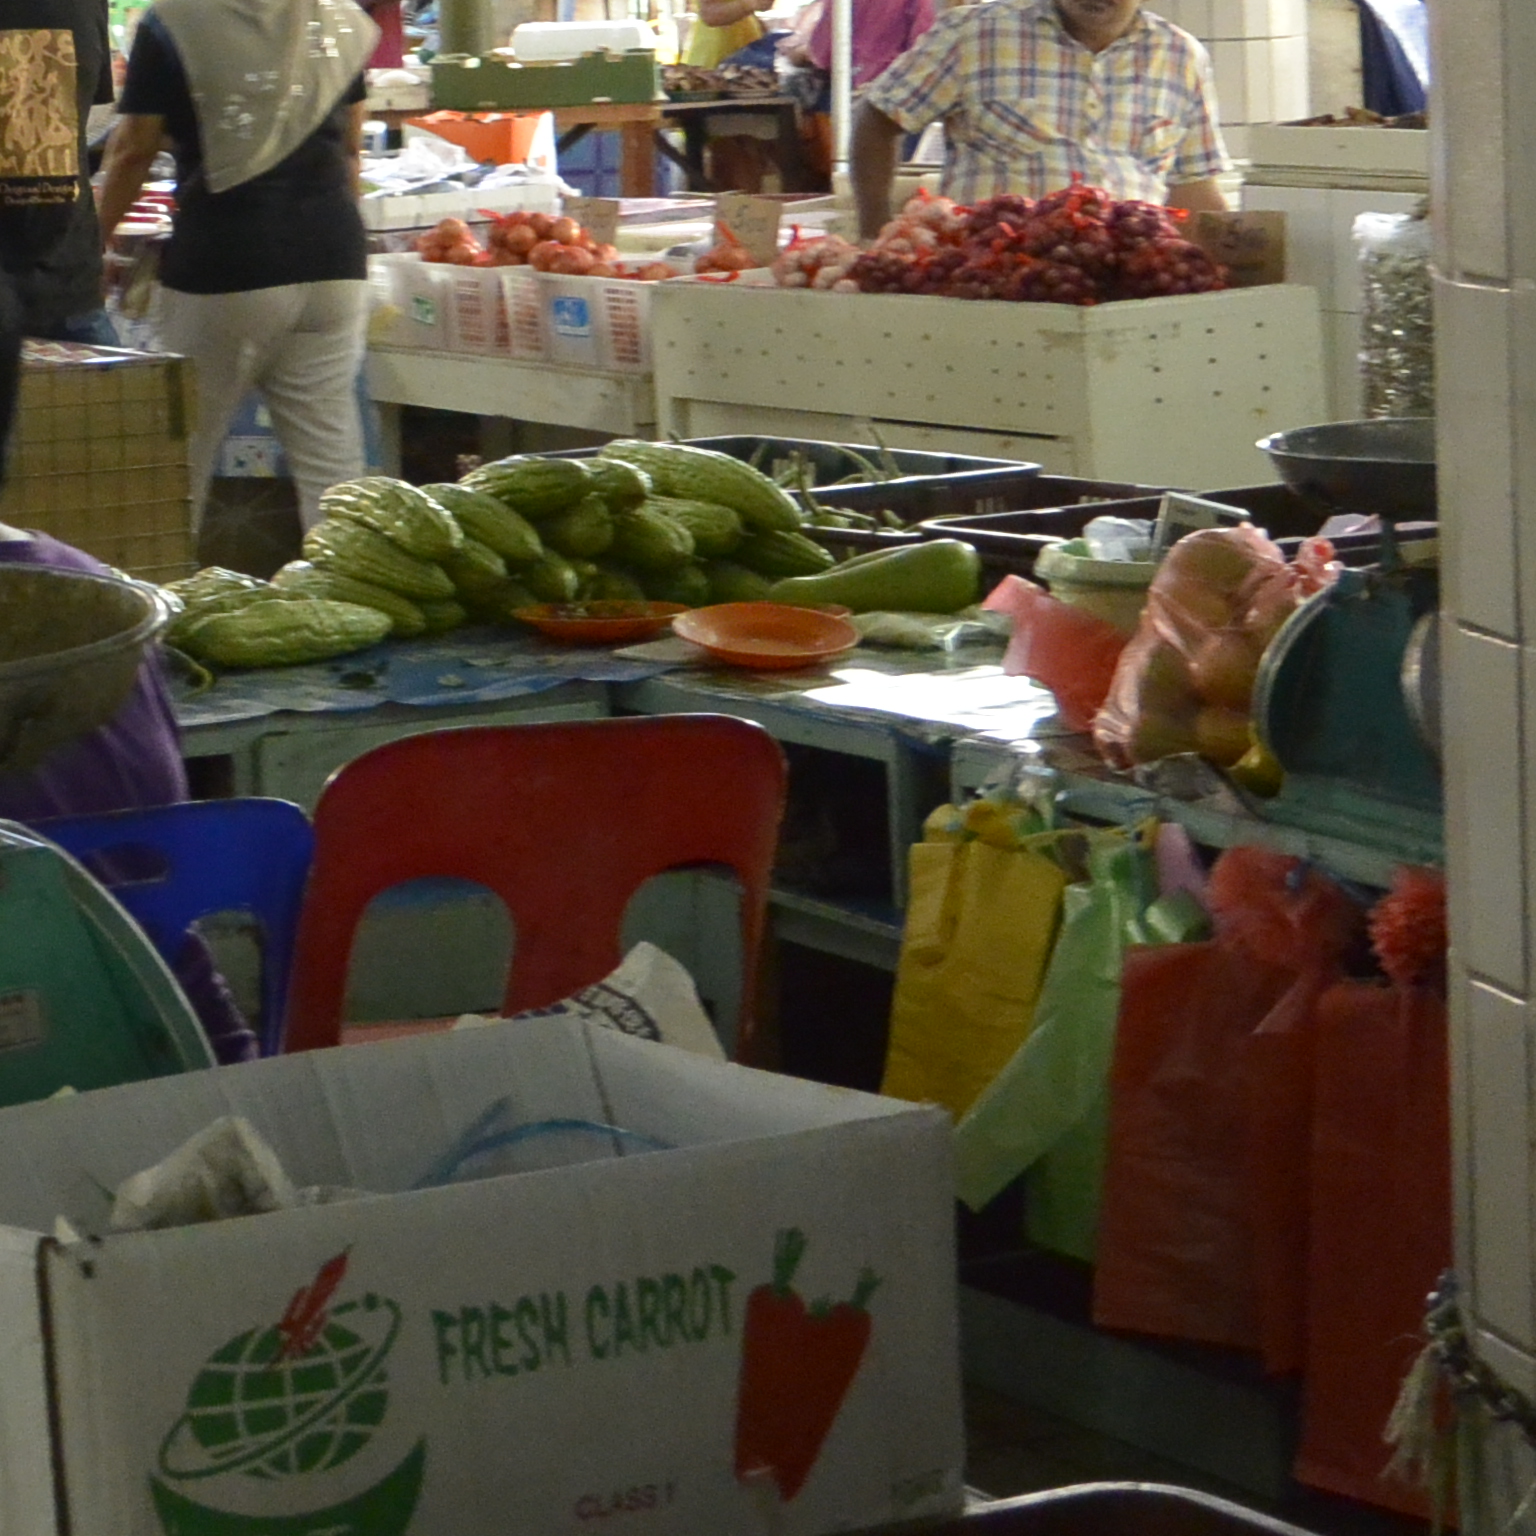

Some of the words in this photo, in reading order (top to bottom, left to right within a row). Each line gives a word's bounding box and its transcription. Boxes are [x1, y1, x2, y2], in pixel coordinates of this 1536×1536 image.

[431, 1290, 571, 1386] FRESH
[584, 1264, 738, 1358] CARROT
[573, 1484, 659, 1522] CLASS
